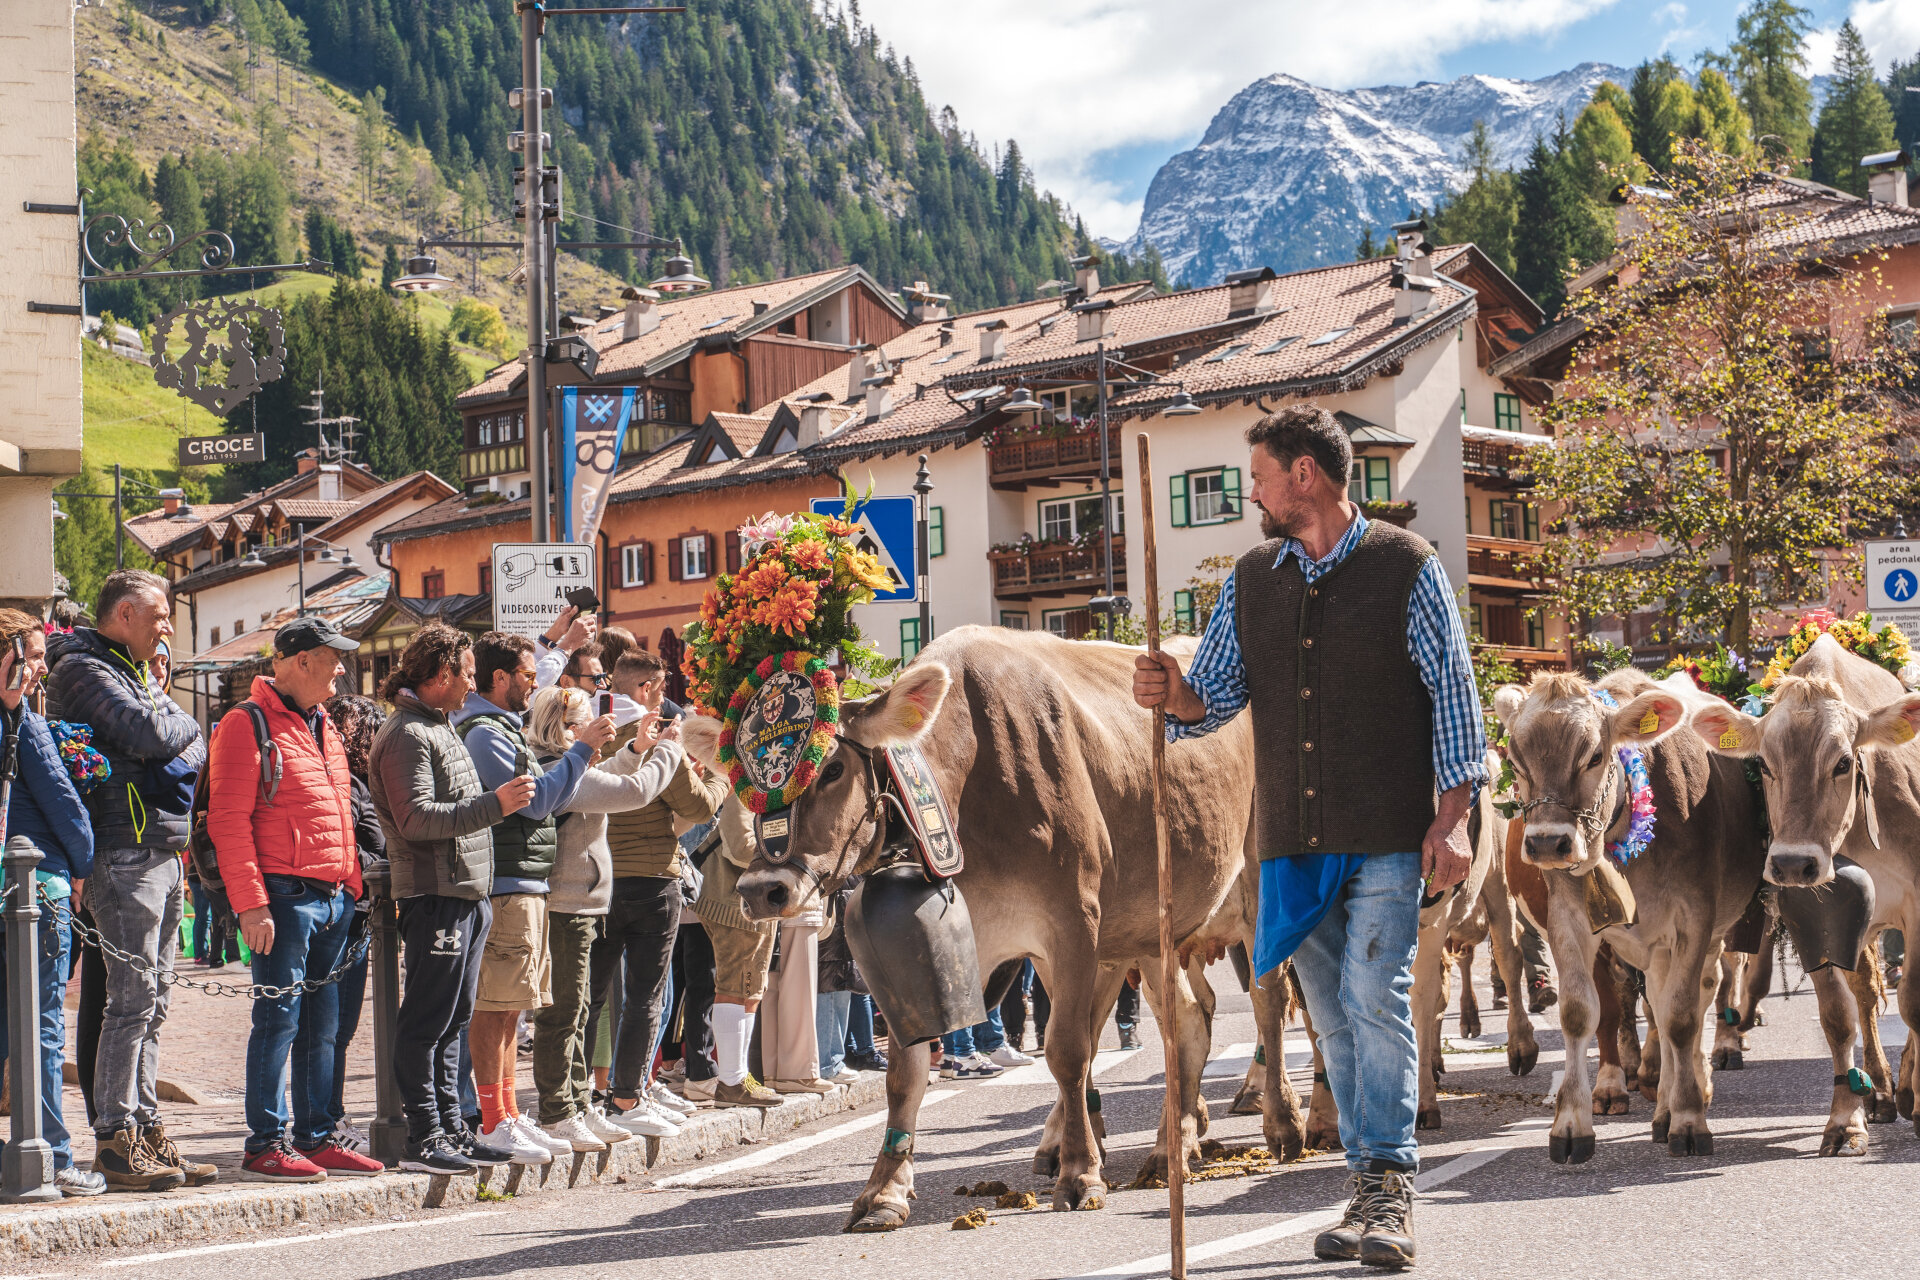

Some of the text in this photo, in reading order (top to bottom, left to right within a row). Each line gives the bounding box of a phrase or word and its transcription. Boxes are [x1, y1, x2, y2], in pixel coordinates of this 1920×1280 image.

[187, 437, 255, 455] CROCE
[220, 452, 238, 460] 1953
[555, 585, 587, 599] AR
[759, 719, 790, 738] MALGA
[760, 722, 810, 744] PELLEGRINO
